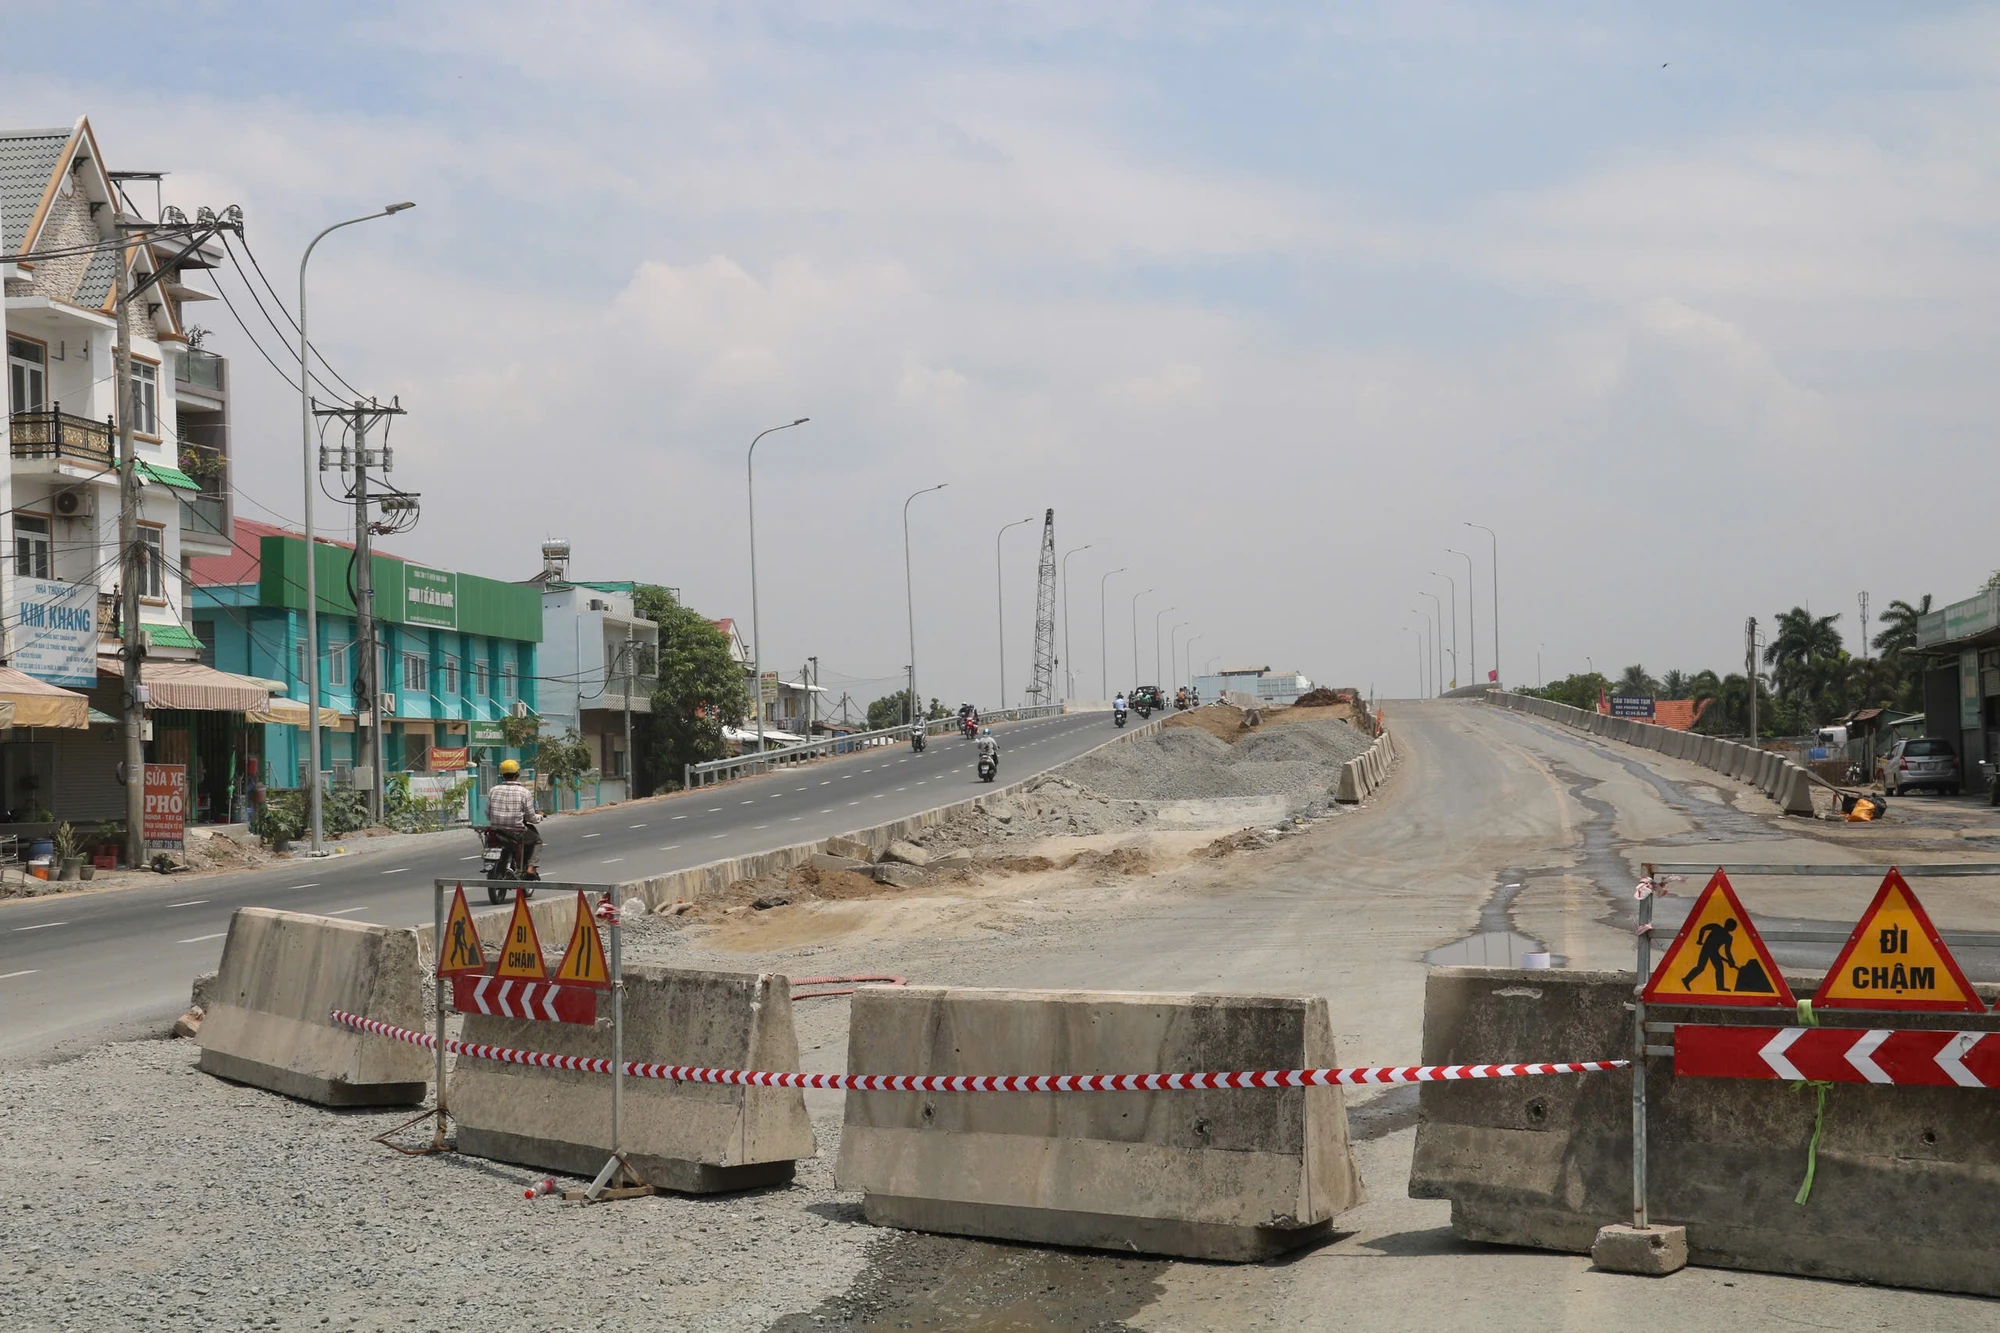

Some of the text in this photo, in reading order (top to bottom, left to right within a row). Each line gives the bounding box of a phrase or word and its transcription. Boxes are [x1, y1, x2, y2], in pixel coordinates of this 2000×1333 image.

[21, 601, 91, 633] KIM KHANG
[145, 766, 184, 787] SỬA XE
[145, 787, 183, 814] PHỐ
[516, 925, 527, 943] ĐI
[1879, 929, 1908, 954] ĐI
[508, 949, 536, 972] CHẬM
[1852, 962, 1935, 994] CHẬM
